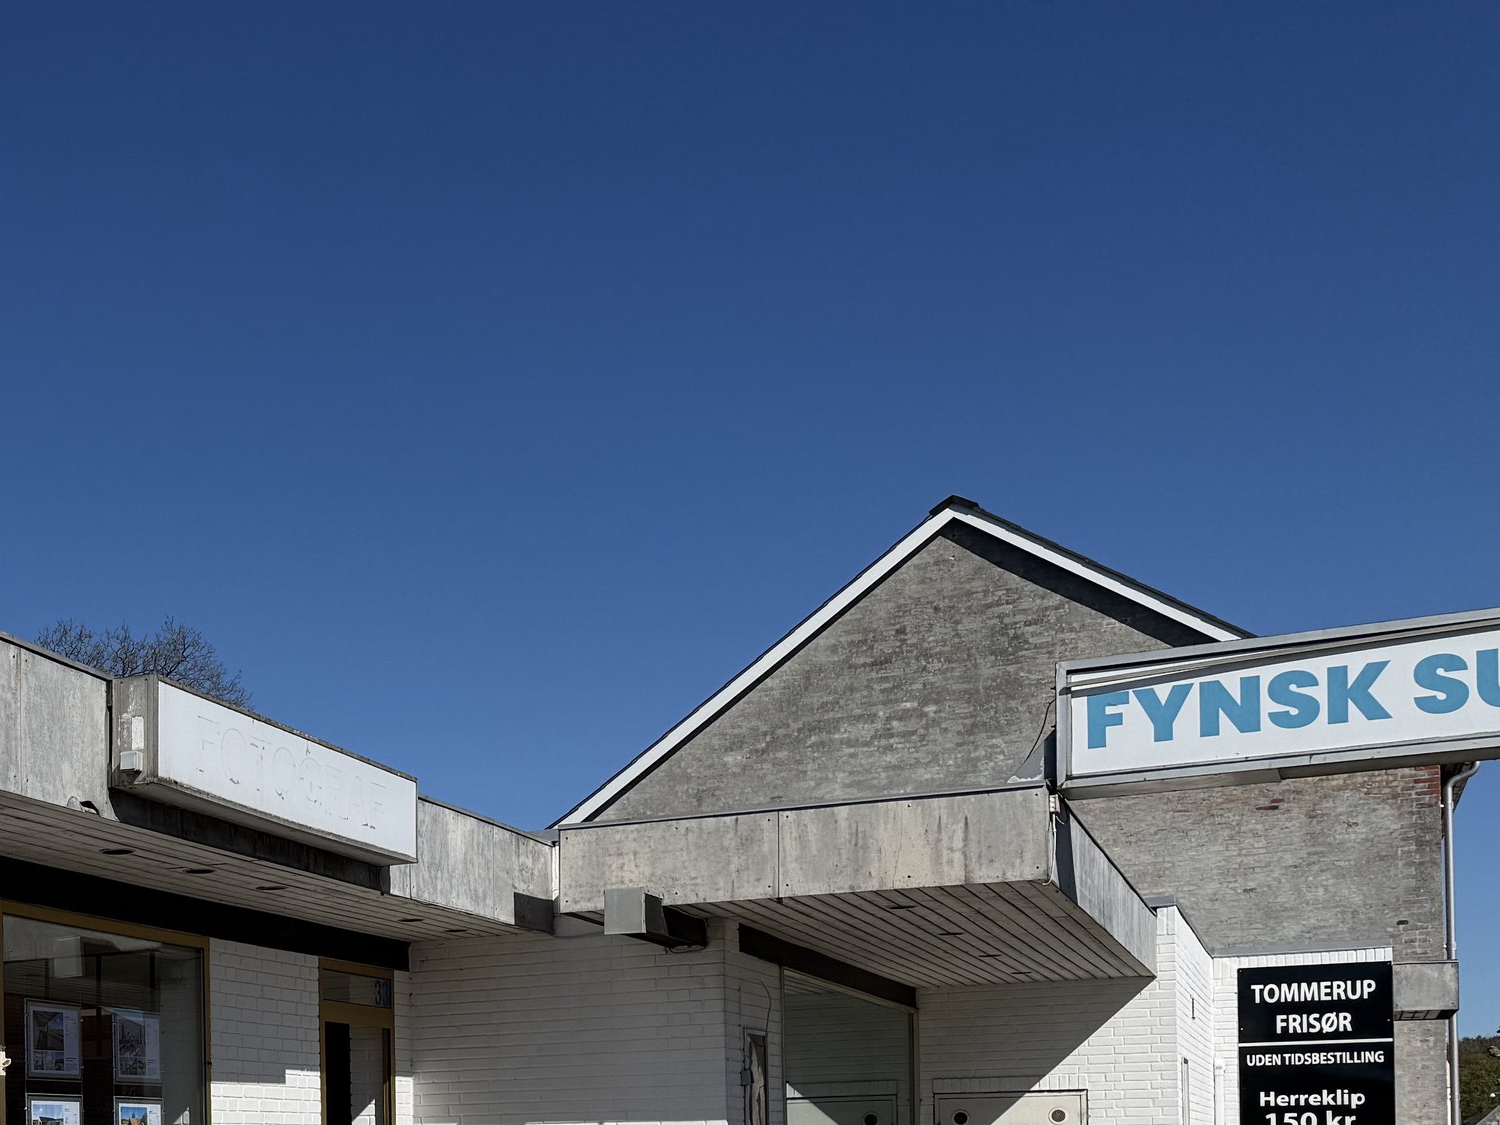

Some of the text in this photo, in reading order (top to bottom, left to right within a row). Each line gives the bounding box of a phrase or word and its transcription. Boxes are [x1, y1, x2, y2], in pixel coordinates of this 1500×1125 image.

[1086, 660, 1393, 750] FYNSK
[1250, 979, 1377, 1004] TOMMERUP
[1276, 1012, 1353, 1034] FRISØR
[1246, 1051, 1385, 1066] UDEN TIDSBESTILLING
[1259, 1089, 1366, 1109] Herreklip
